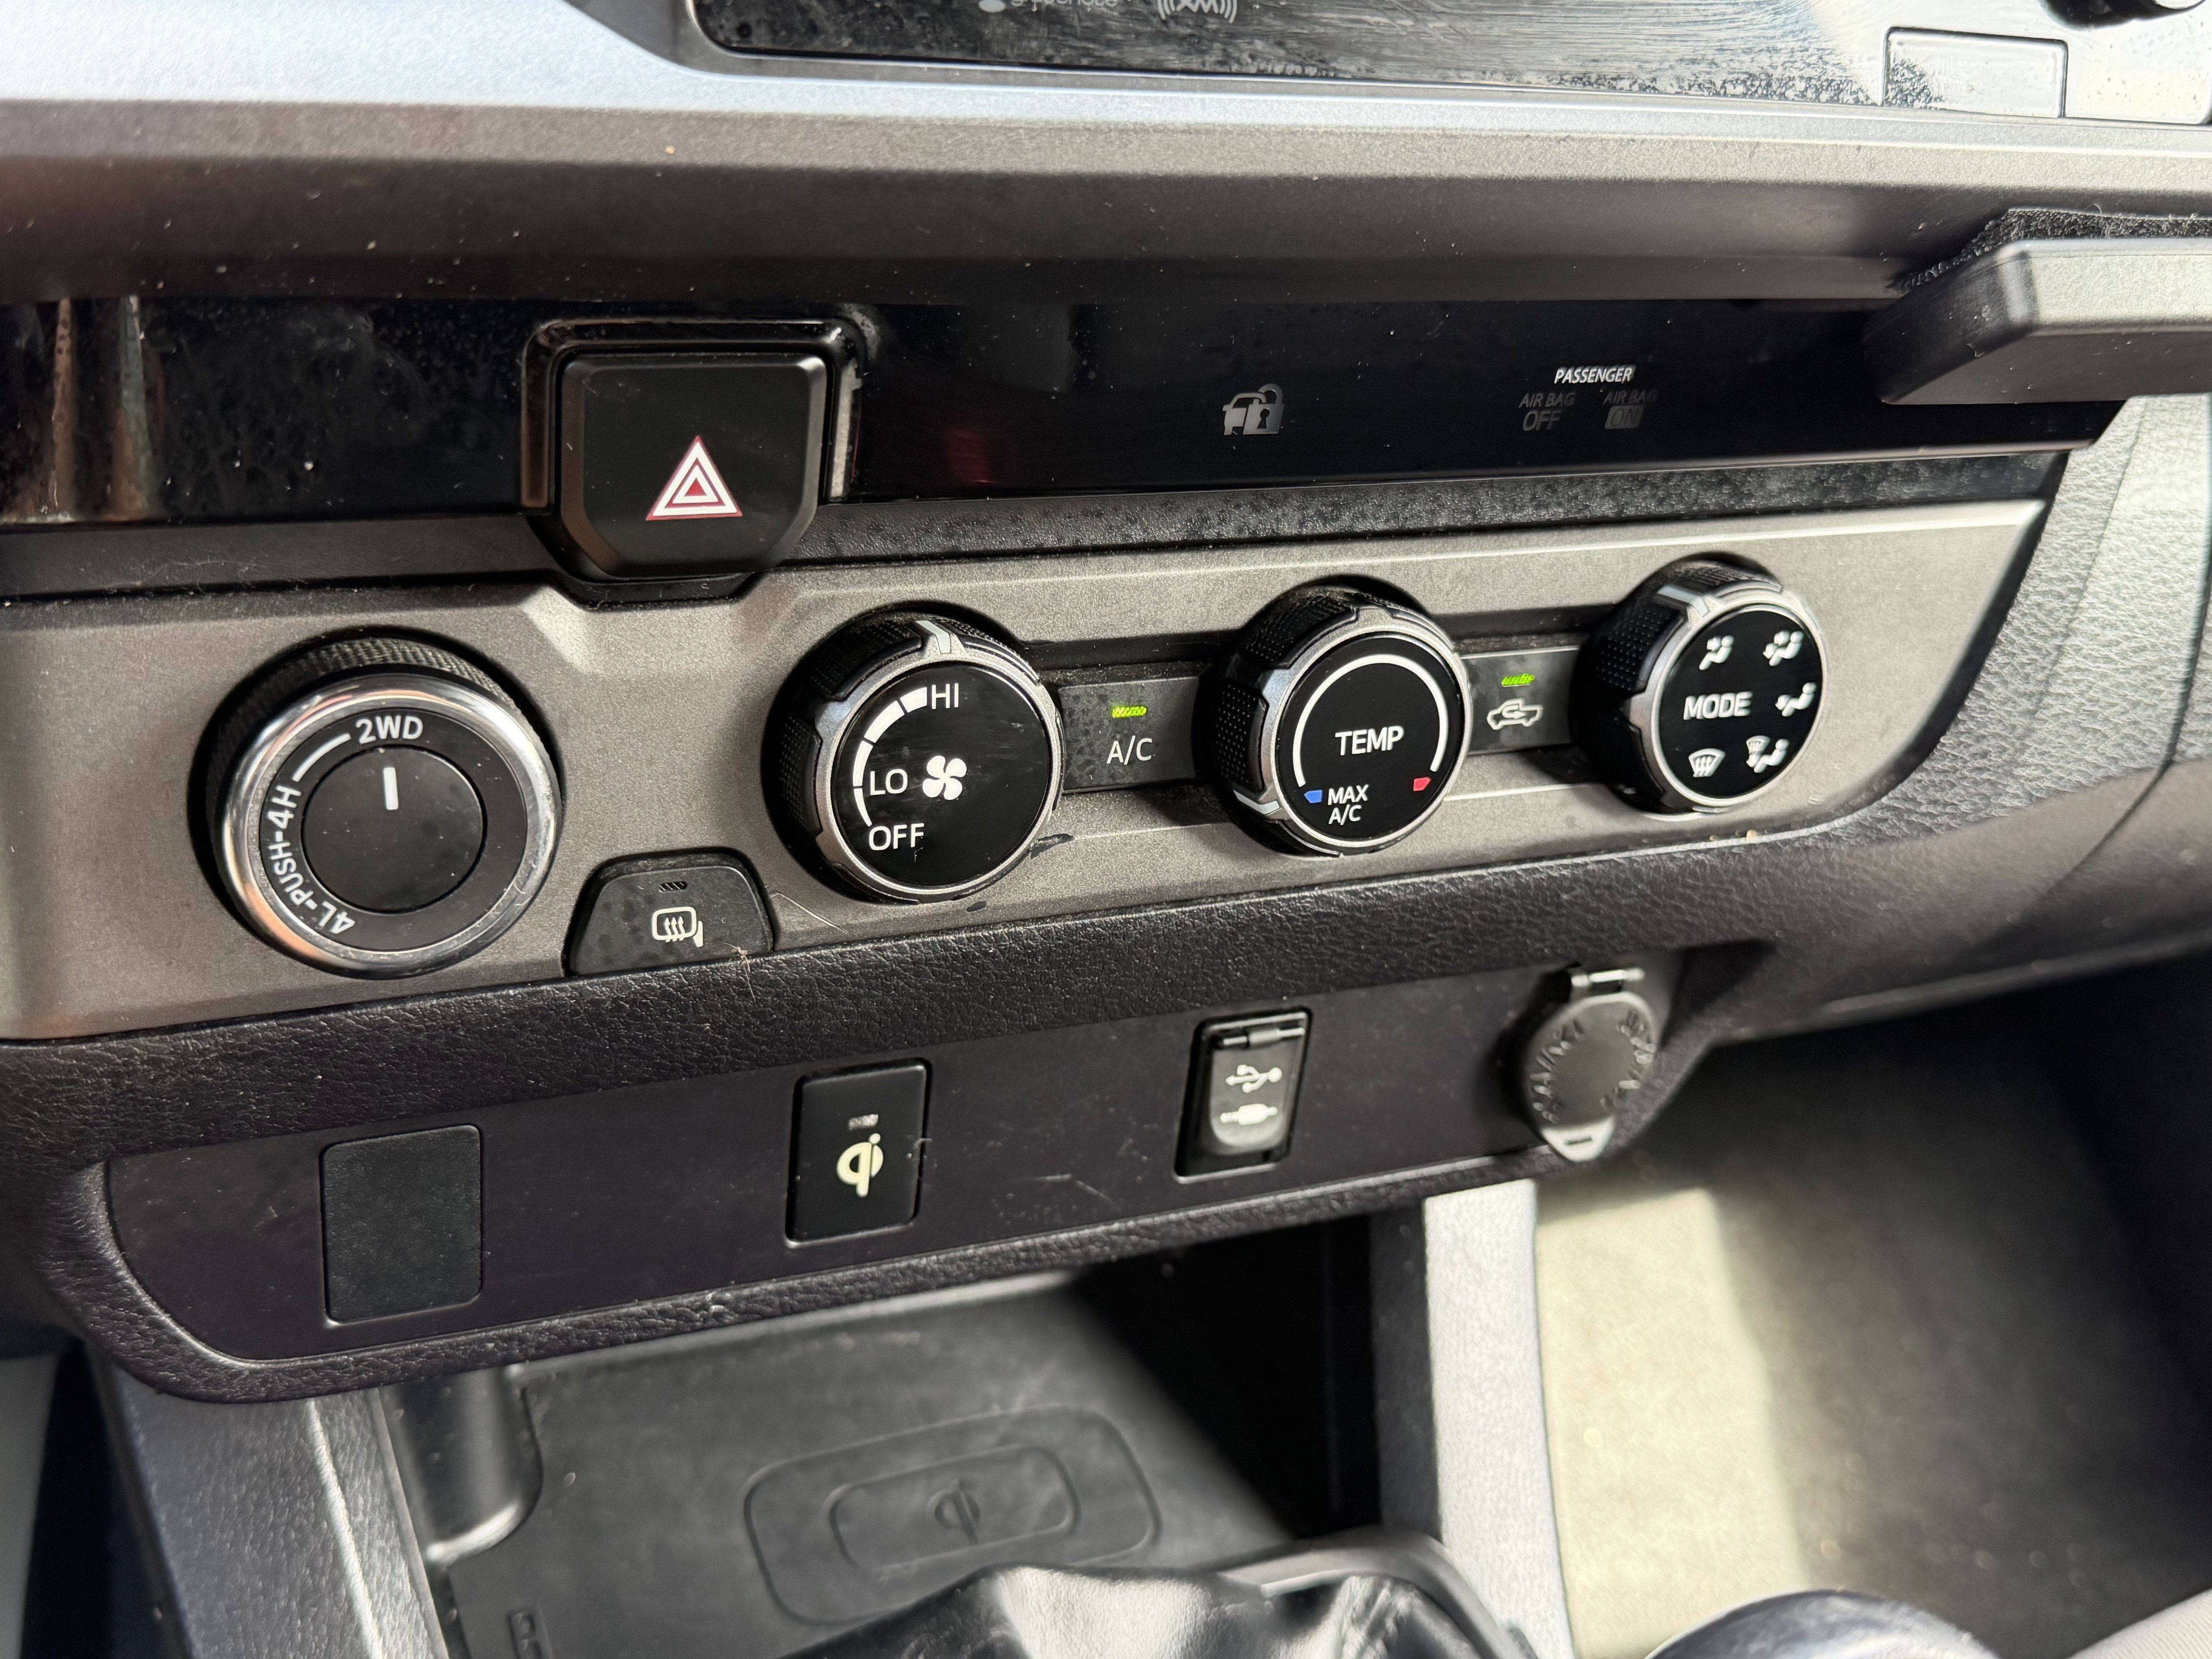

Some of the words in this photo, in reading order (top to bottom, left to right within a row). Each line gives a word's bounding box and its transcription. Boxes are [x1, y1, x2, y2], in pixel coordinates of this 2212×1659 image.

[1554, 365, 1636, 384] PASSENGER
[1519, 392, 1544, 408] AIR
[1545, 391, 1577, 407] BAG
[1603, 390, 1628, 405] AIR
[1628, 389, 1658, 404] BAG
[1523, 409, 1562, 431] OFF
[1610, 407, 1640, 427] ON
[931, 683, 959, 709] HI
[1683, 691, 1753, 720] MODE
[356, 716, 424, 744] 2WD
[1335, 725, 1405, 756] TEMP
[1106, 735, 1152, 765] A/C
[870, 769, 908, 795] LO
[1328, 784, 1369, 806] MAX
[1328, 804, 1362, 826] A/C
[869, 823, 925, 851] OFF
